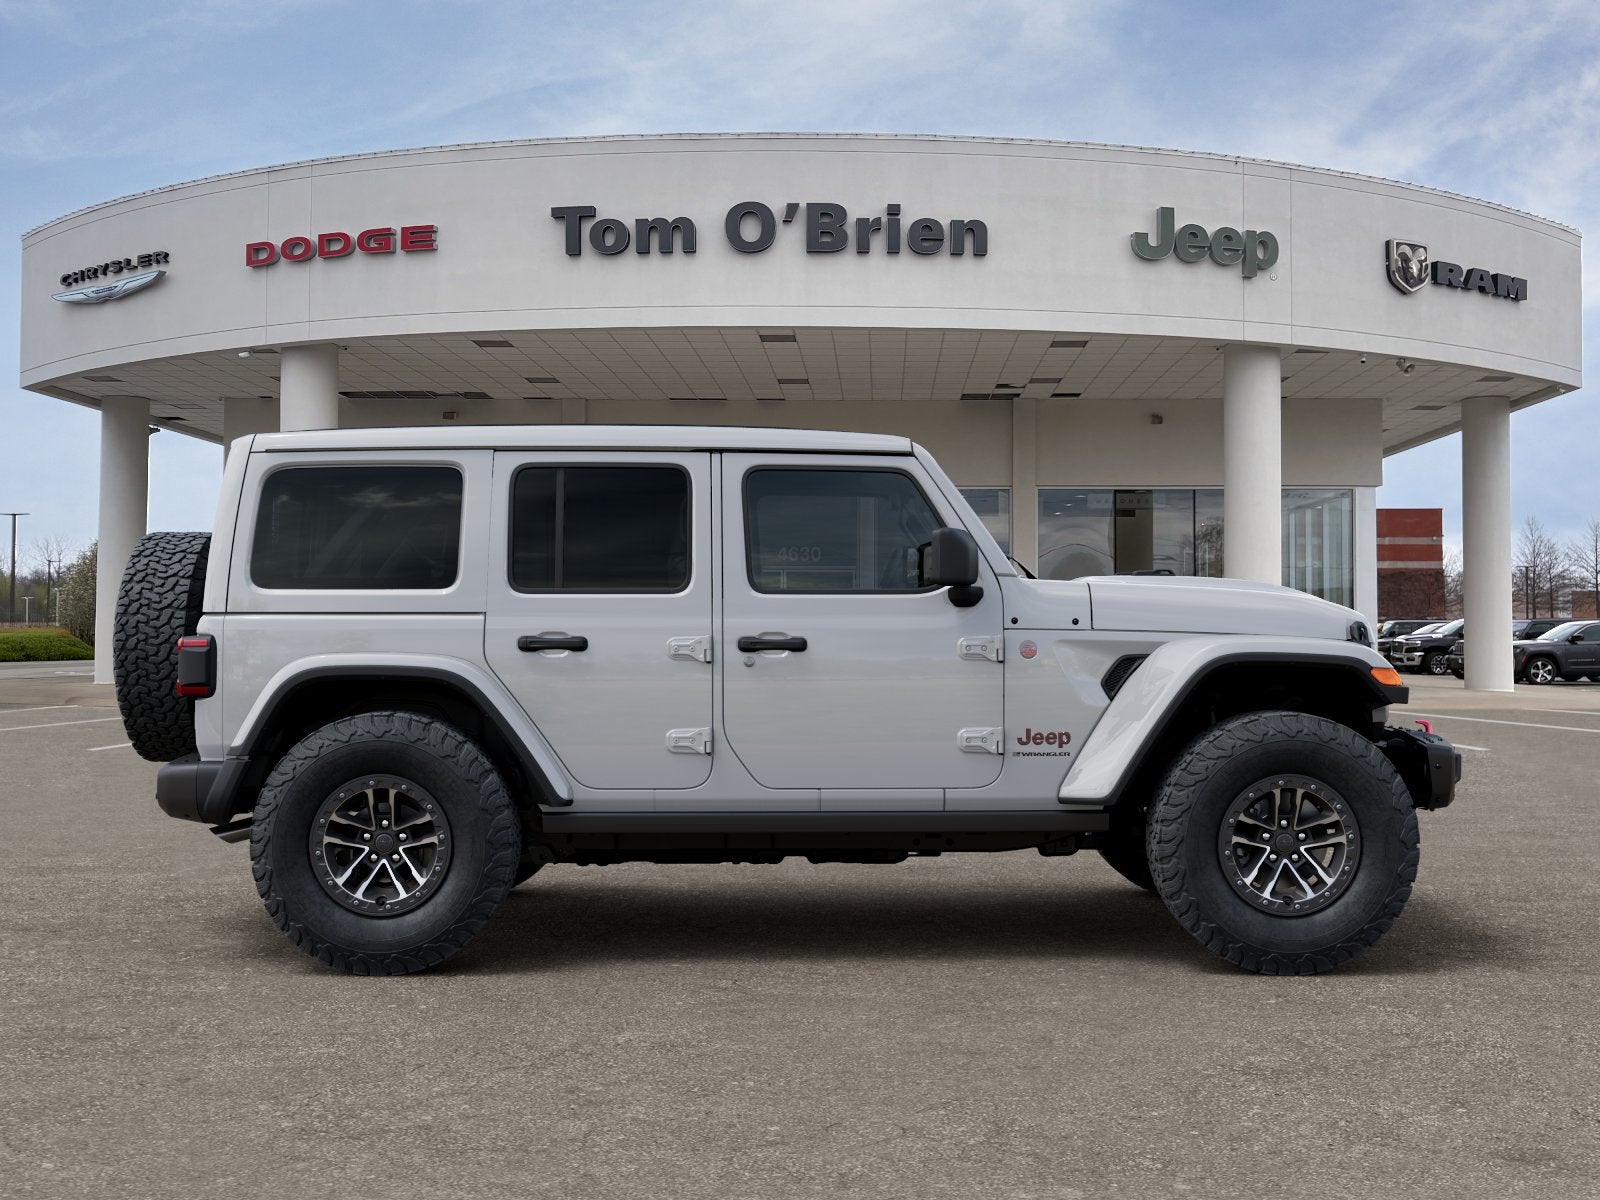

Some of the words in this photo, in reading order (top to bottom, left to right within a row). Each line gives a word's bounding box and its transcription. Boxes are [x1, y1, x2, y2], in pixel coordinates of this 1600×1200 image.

[245, 224, 438, 269] DODGE
[551, 205, 697, 256] Tom
[725, 201, 988, 256] O'Brien
[1130, 206, 1280, 278] Jeep
[59, 249, 171, 287] CHRYSLER
[1431, 260, 1528, 301] RAM
[777, 546, 821, 562] 4630
[1016, 727, 1072, 749] Jeep
